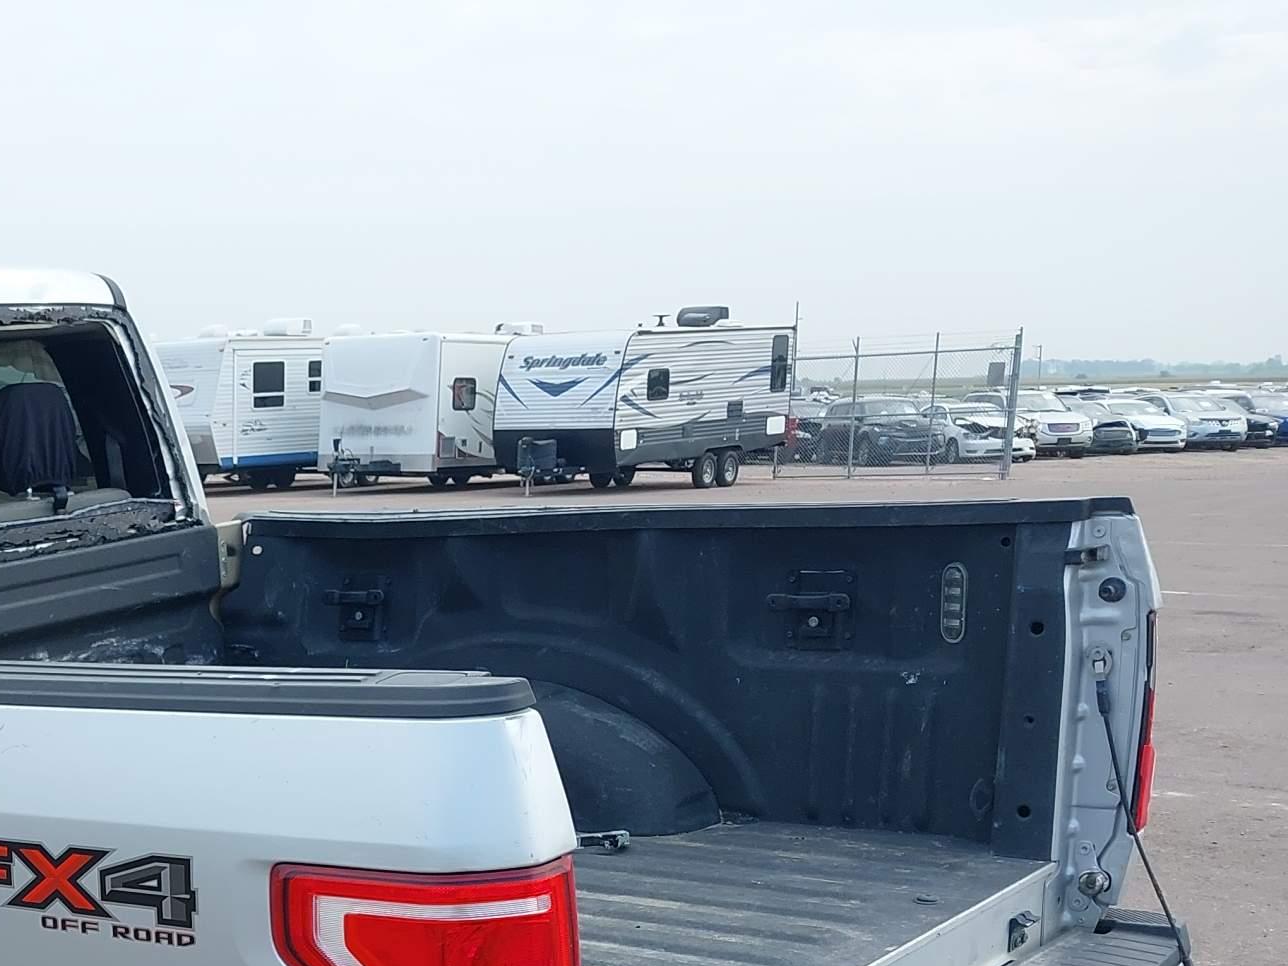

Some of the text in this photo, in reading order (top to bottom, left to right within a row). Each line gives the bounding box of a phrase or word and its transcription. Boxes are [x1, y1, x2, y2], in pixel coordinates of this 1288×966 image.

[519, 353, 607, 371] Springdale
[41, 915, 196, 947] OFF ROAD
